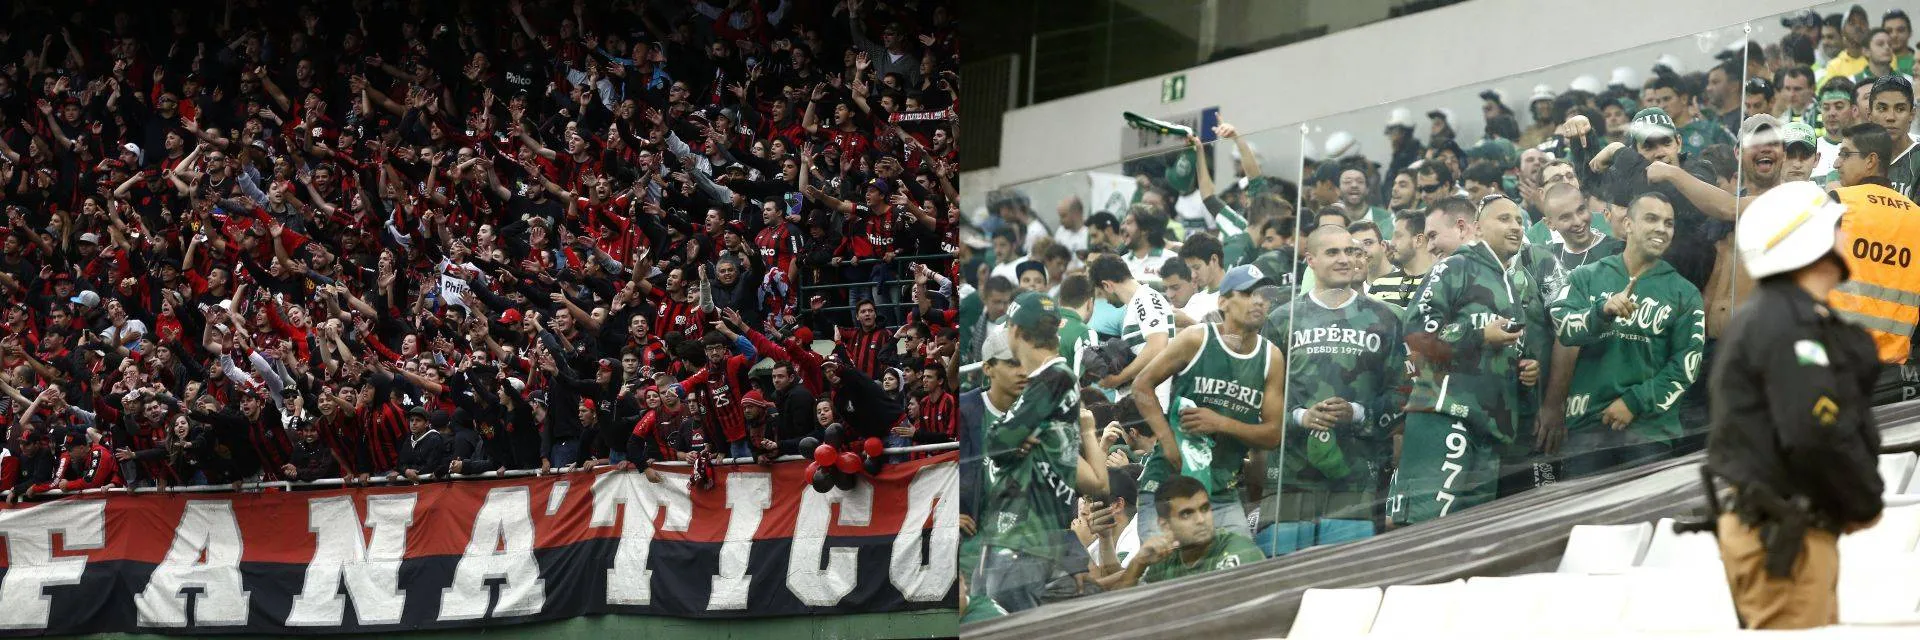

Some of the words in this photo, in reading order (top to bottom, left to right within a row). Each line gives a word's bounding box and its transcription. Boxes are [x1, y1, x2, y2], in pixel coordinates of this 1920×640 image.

[506, 71, 532, 86] Philco
[1867, 194, 1912, 211] STAFF
[867, 232, 894, 245] hilco
[1852, 237, 1912, 269] 0020
[1289, 323, 1381, 352] MPÉRIO
[1306, 345, 1339, 354] DESDE
[1340, 346, 1364, 356] 1977
[713, 393, 730, 408] 25
[1231, 403, 1250, 414] 1977
